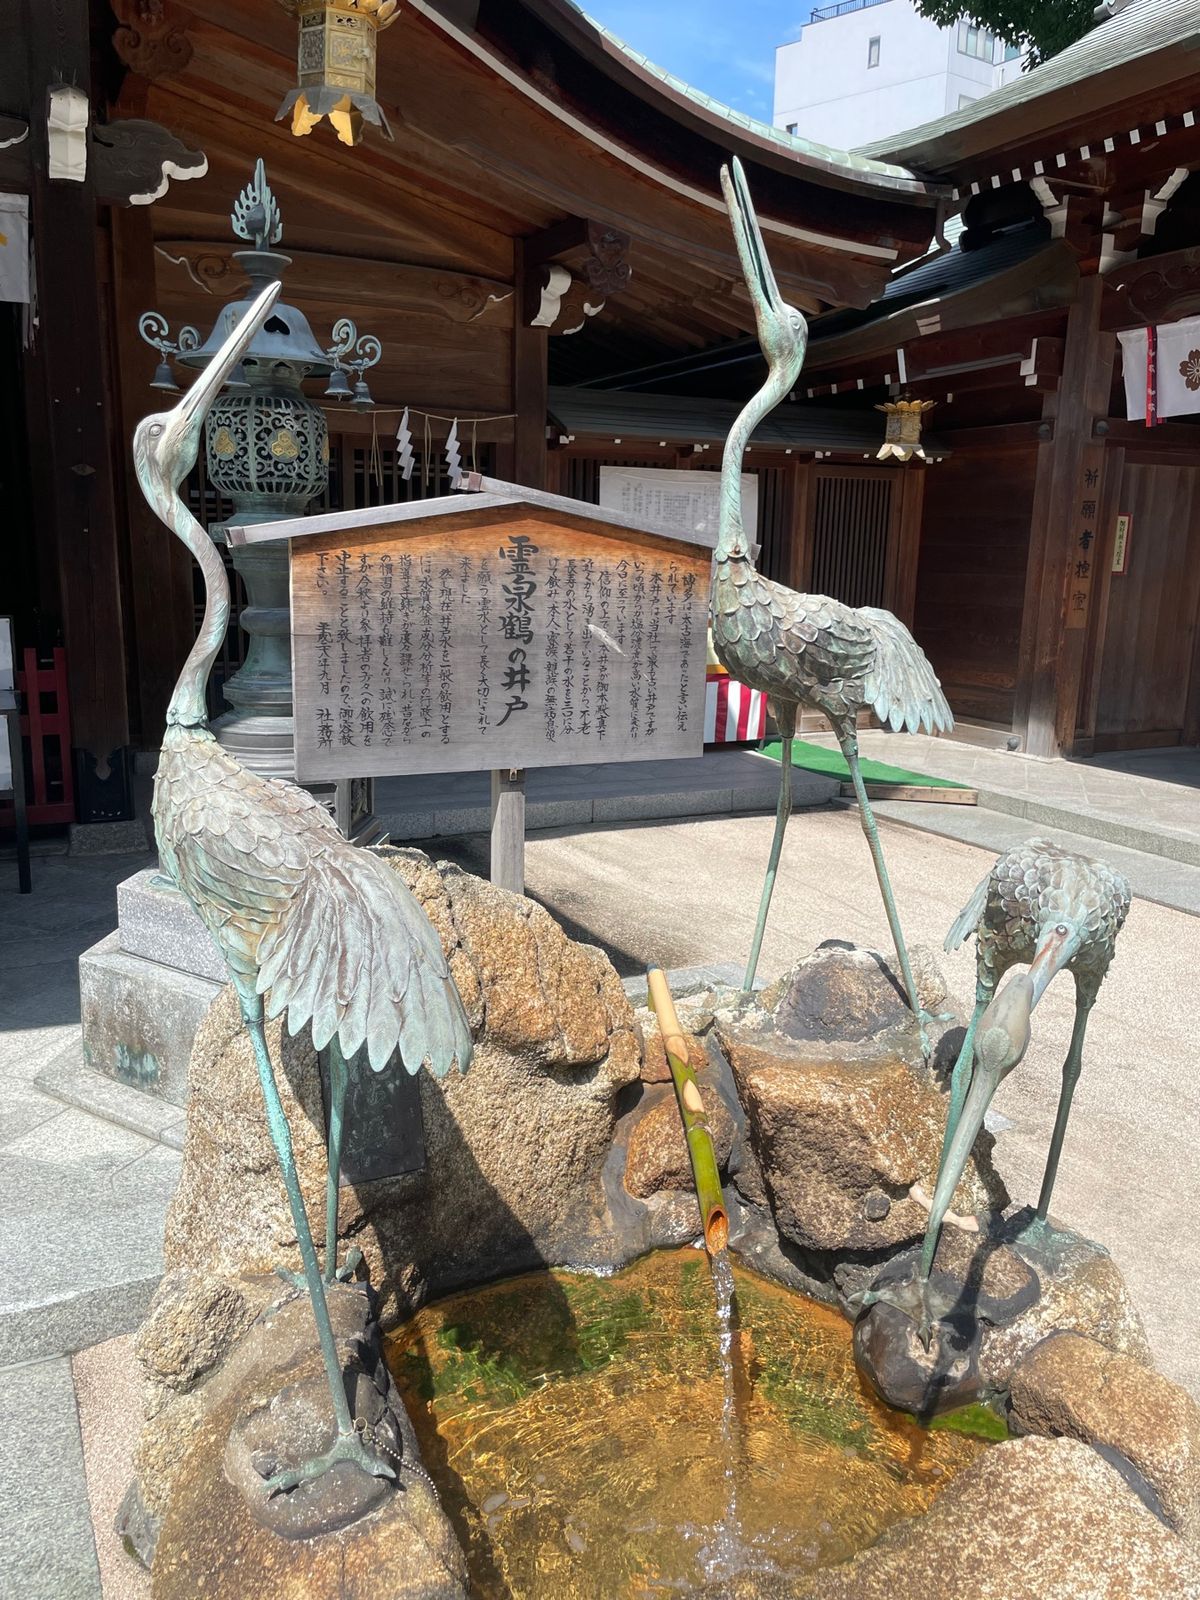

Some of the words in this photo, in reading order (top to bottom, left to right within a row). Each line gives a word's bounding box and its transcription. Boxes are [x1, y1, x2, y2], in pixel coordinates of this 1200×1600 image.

[1072, 468, 1099, 612] 祈願者控室
[315, 552, 330, 596] 下さい。
[460, 556, 473, 604] 来ました
[615, 559, 631, 645] 今日に至っています
[665, 561, 678, 625] られています
[497, 535, 538, 726] 霊泉鶴の井戸
[315, 708, 334, 750] 社務所
